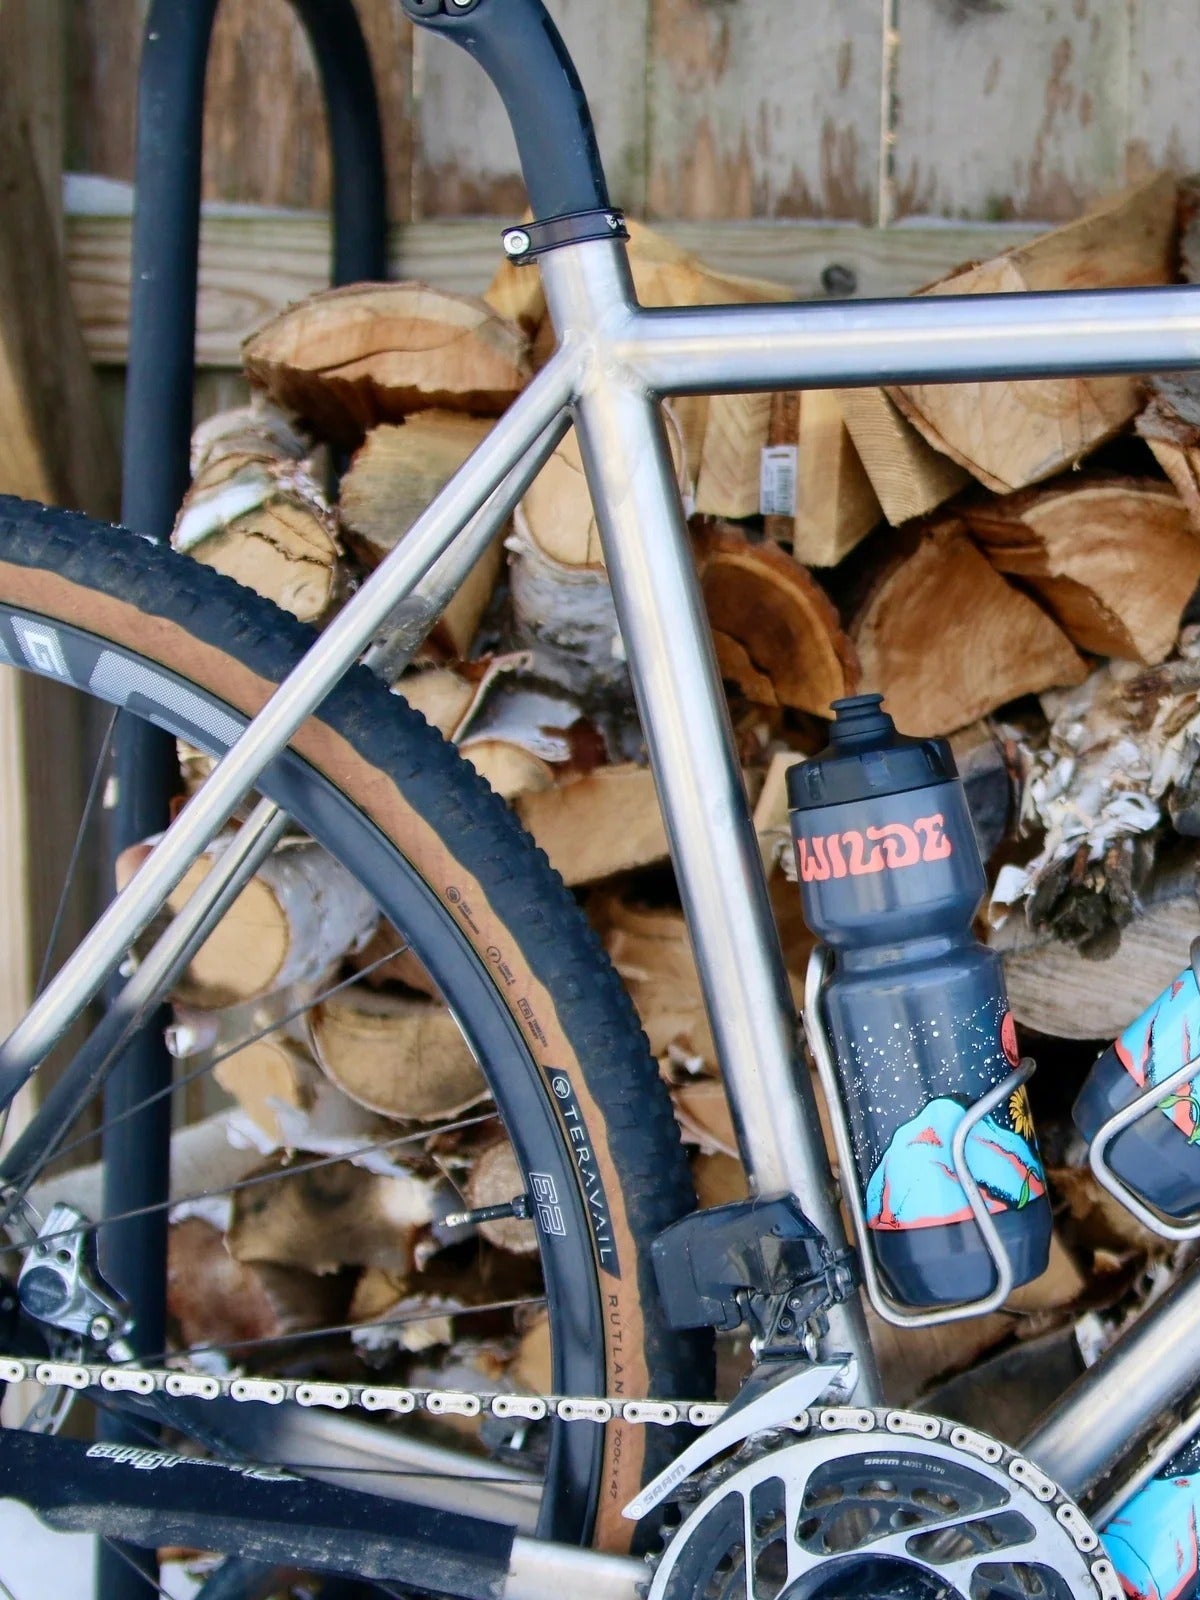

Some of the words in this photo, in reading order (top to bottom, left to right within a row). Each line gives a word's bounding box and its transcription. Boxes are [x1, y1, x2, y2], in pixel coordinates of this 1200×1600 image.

[797, 813, 953, 882] WILDE
[564, 1104, 612, 1264] TERAVAIL
[608, 1294, 625, 1395] RUTLAN
[609, 1480, 618, 1499] 47
[643, 1462, 687, 1507] SRAM
